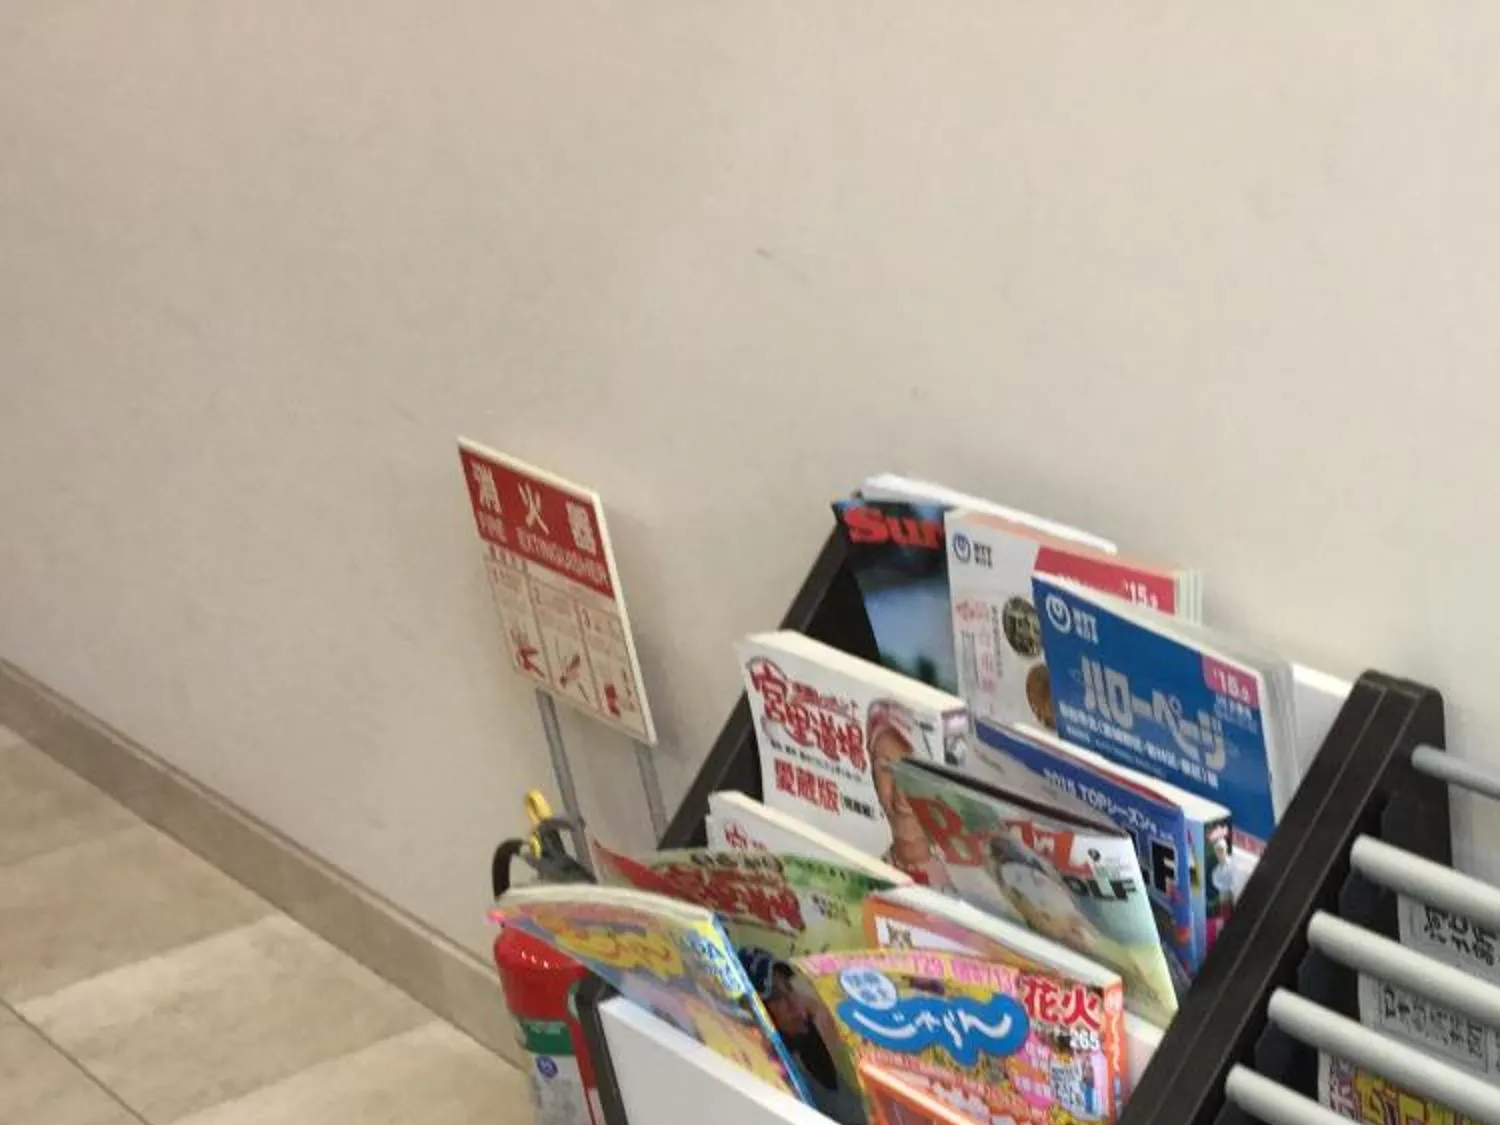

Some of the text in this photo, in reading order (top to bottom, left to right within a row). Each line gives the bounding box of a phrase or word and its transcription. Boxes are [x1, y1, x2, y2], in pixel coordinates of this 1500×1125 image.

[470, 459, 597, 556] 消火器
[1080, 656, 1227, 771] ハローページ
[852, 1008, 1013, 1050] じゃらん
[1022, 974, 1101, 1030] 花火
